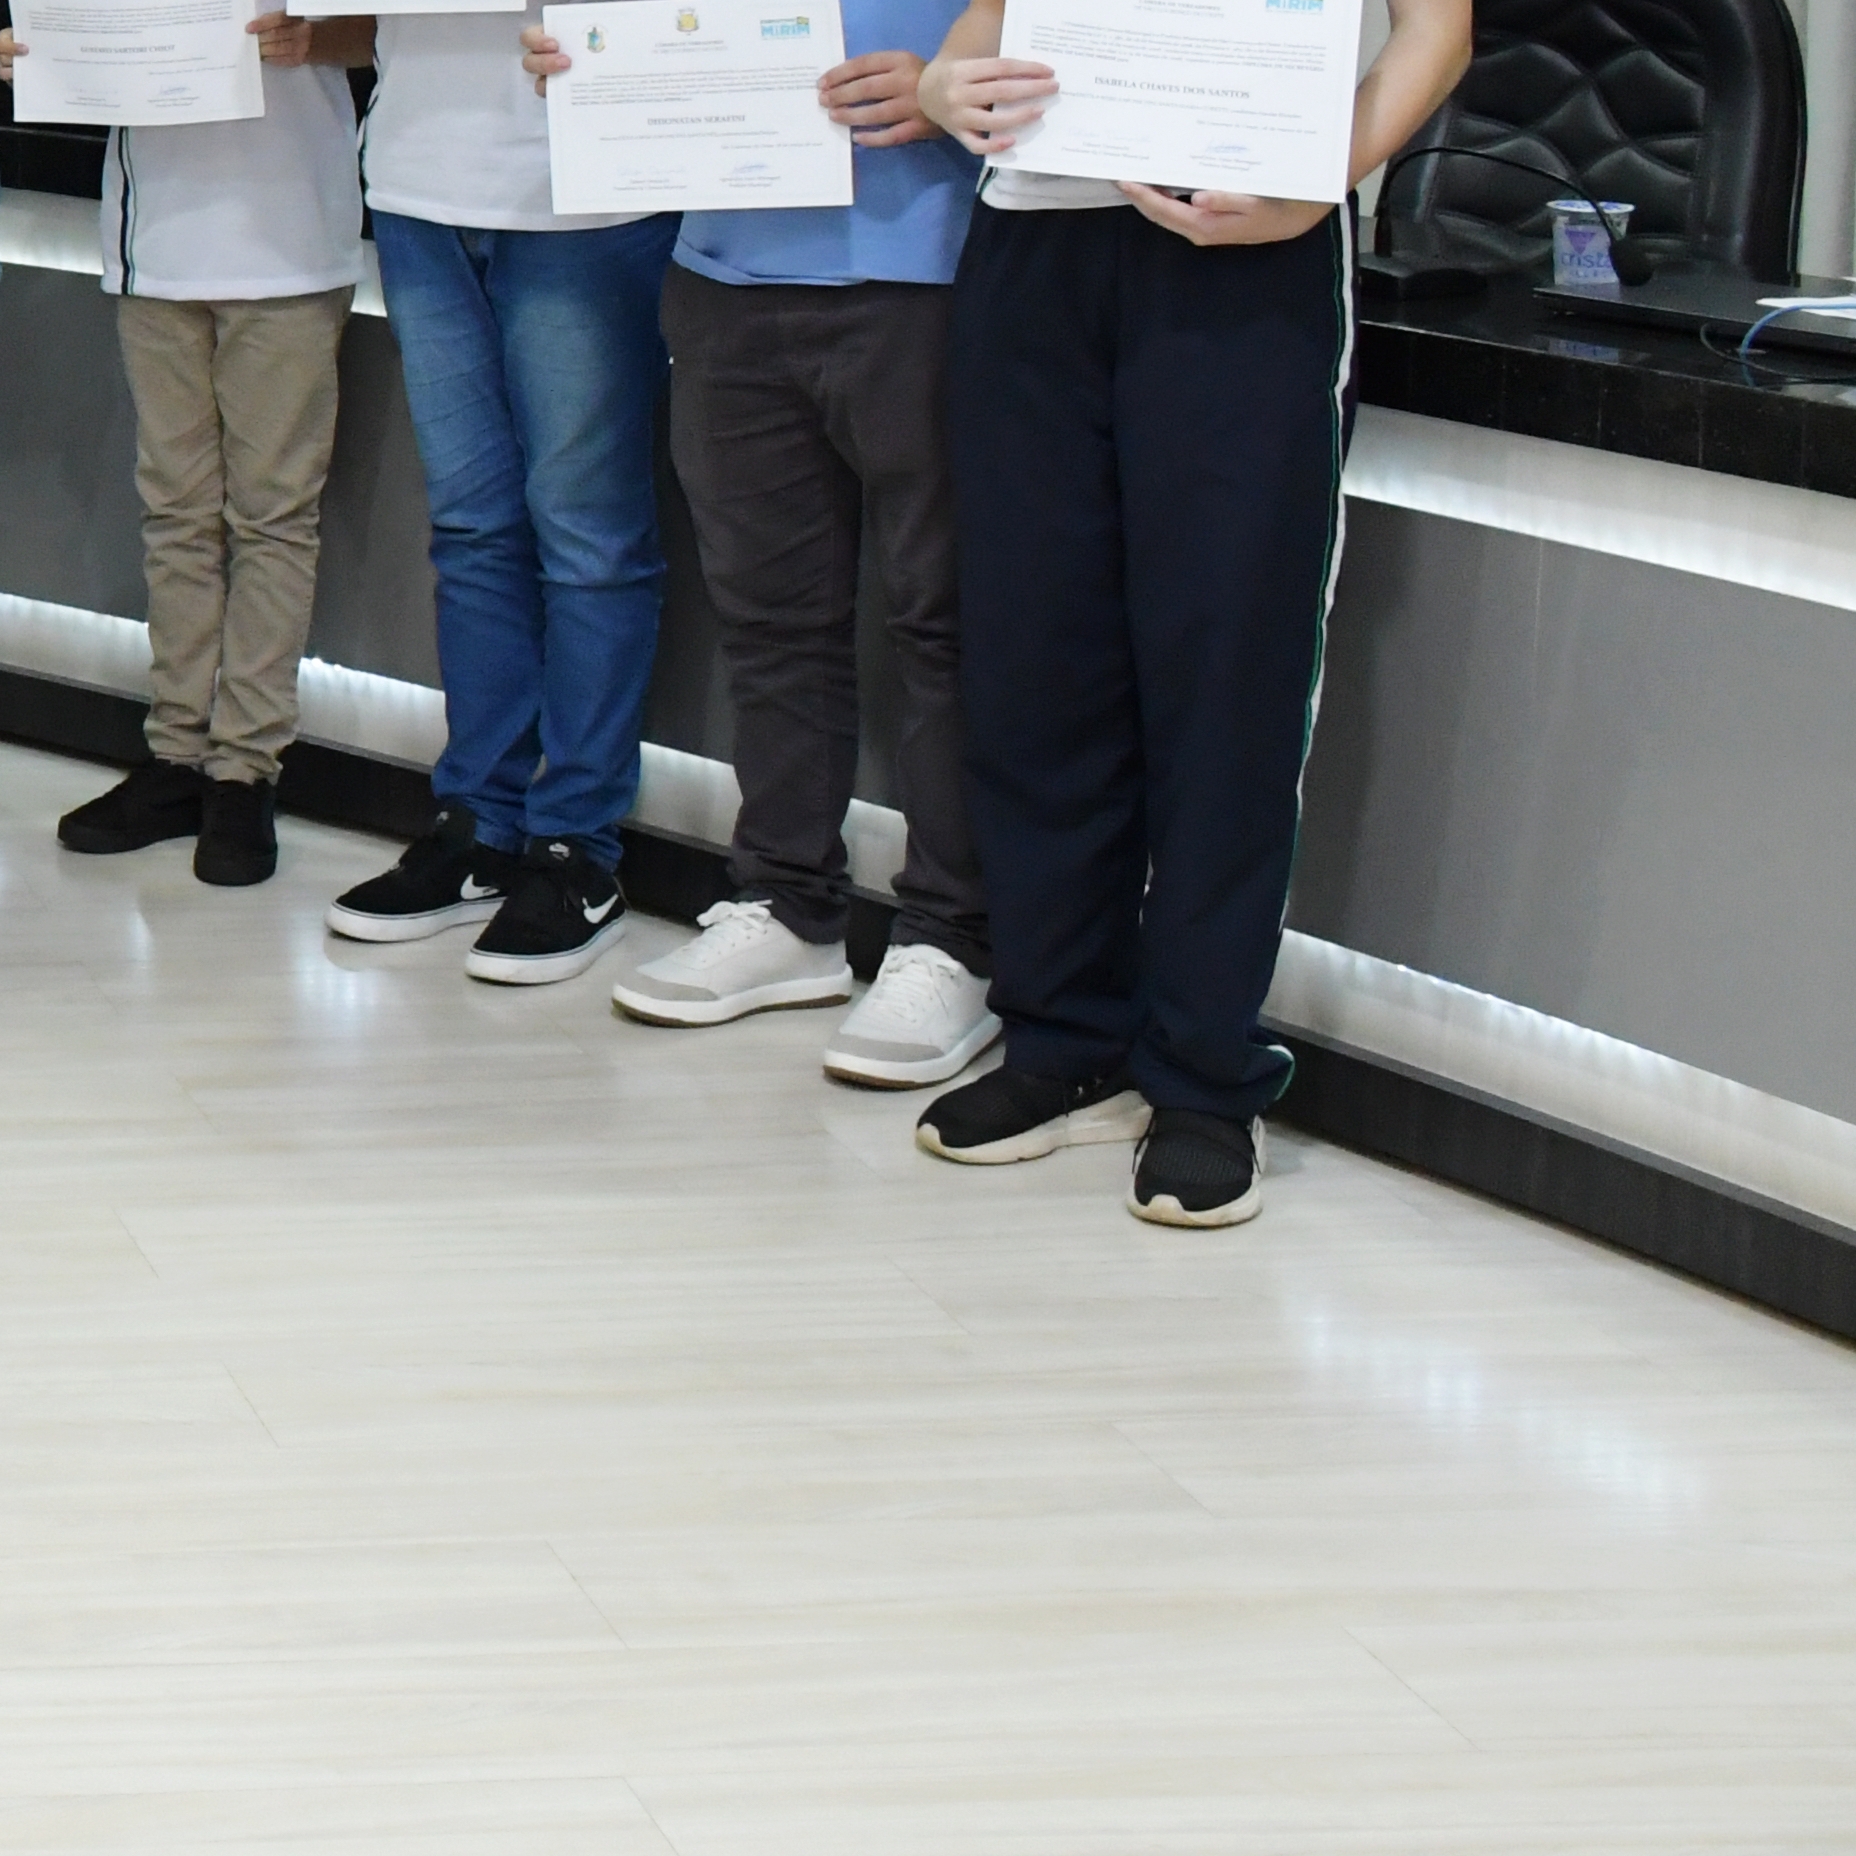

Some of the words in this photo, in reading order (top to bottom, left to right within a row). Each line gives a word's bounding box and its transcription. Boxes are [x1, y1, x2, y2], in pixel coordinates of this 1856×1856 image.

[1094, 76, 1137, 91] ISABELA
[1139, 80, 1180, 94] CHAVES
[1182, 84, 1205, 96] DOS
[1208, 86, 1250, 99] SANTOS
